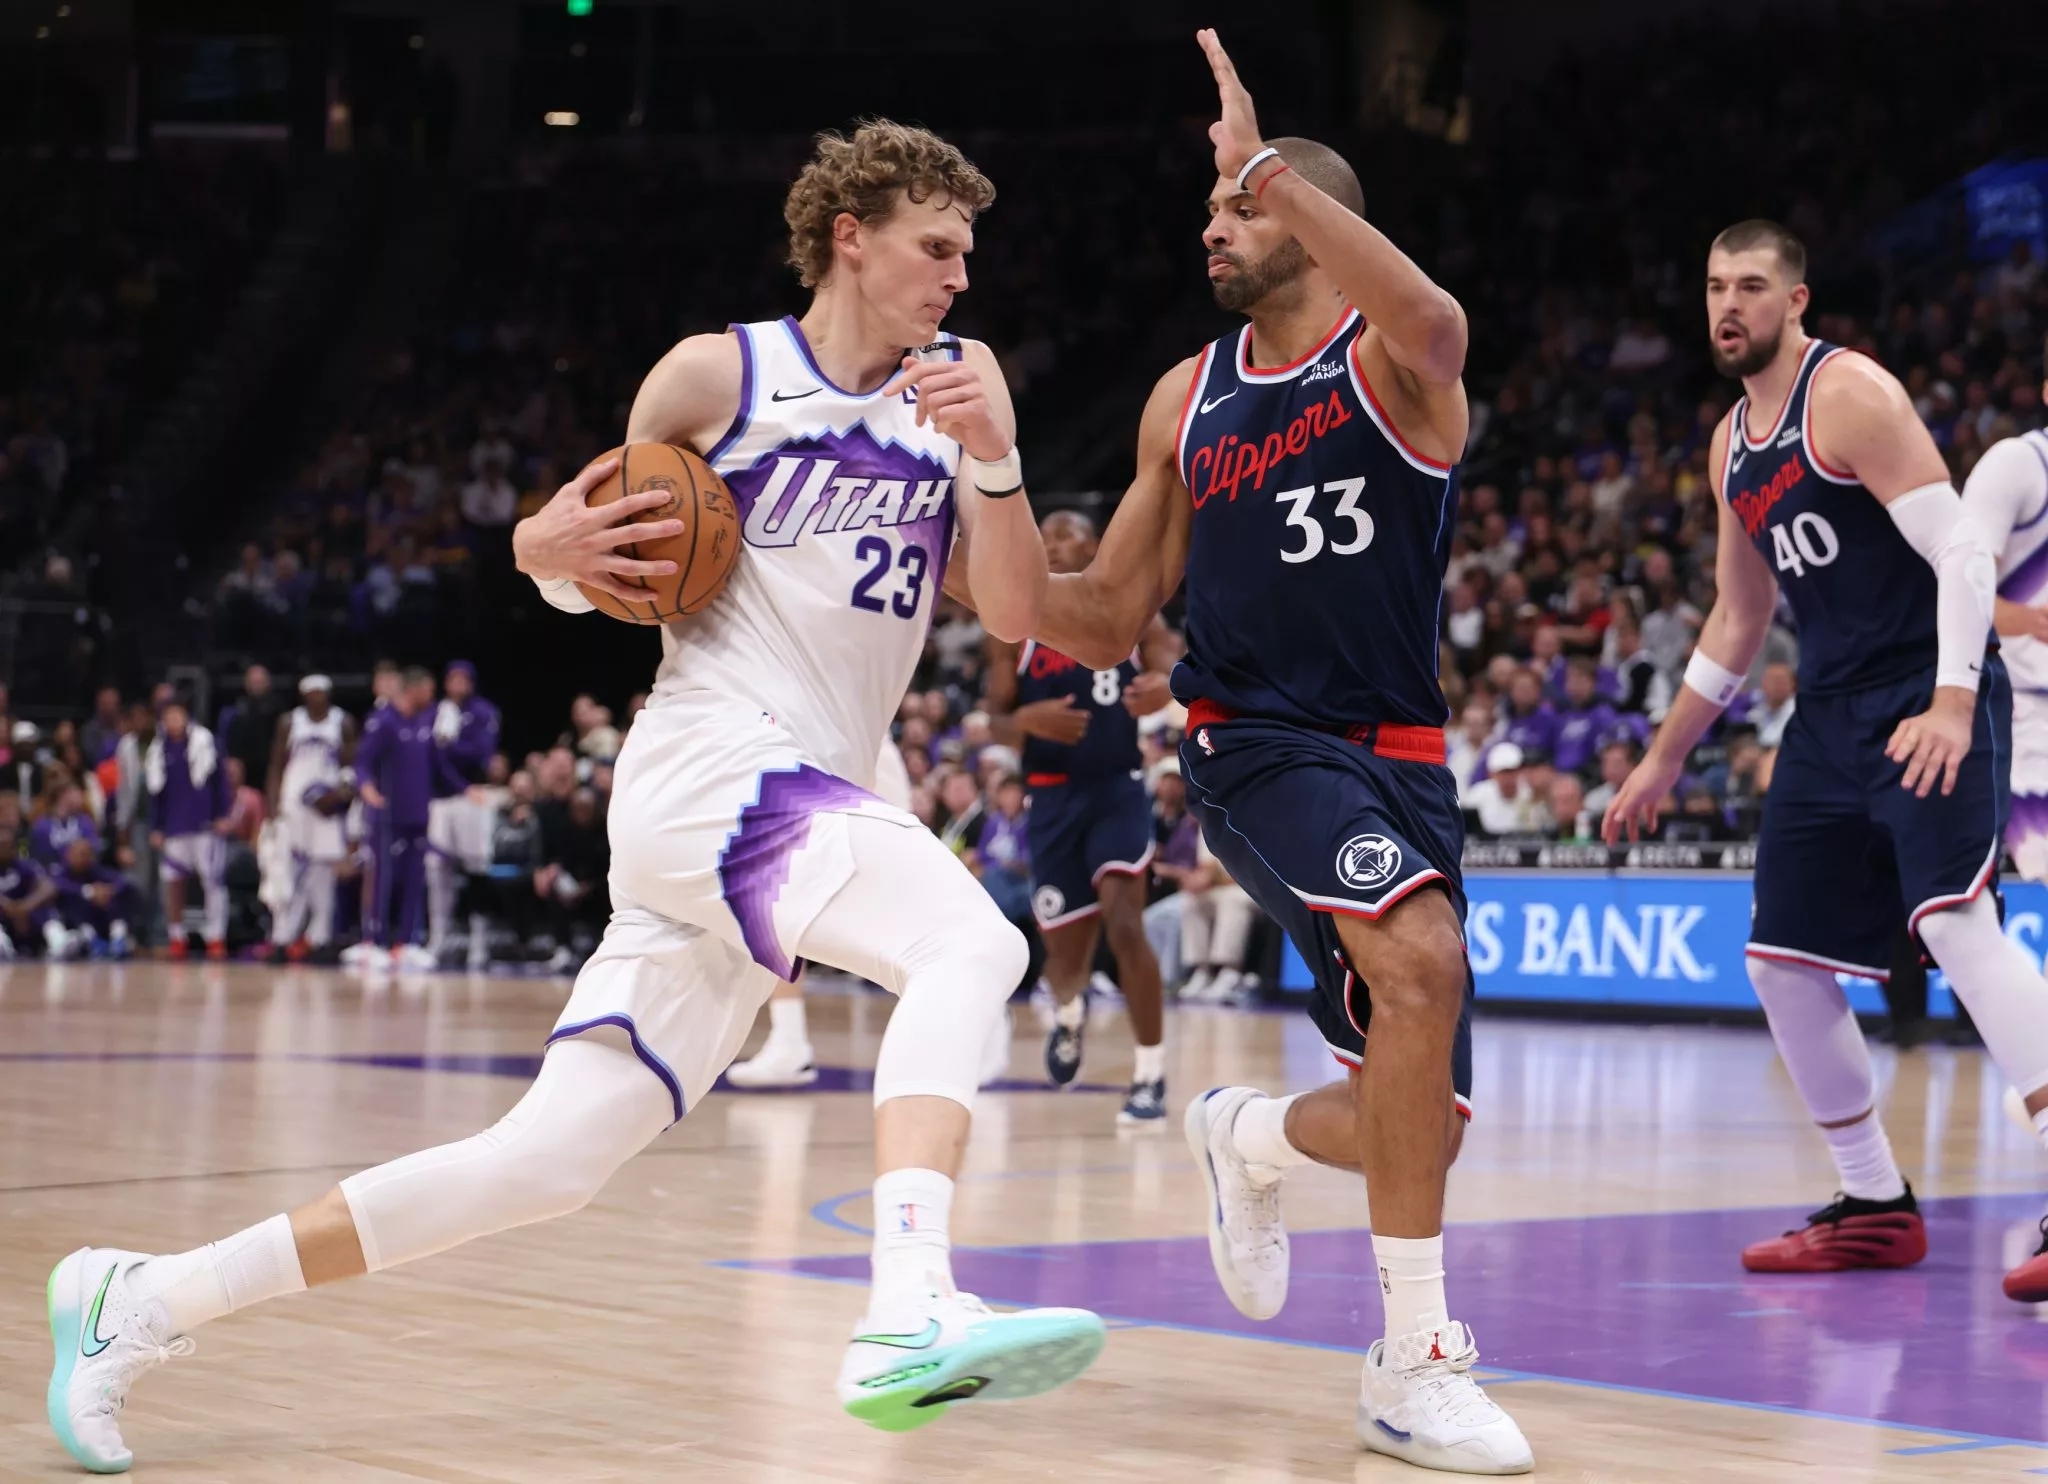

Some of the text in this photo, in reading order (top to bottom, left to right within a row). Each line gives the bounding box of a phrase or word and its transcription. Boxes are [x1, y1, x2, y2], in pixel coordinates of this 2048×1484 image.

[1301, 364, 1345, 387] RWANDA
[1311, 360, 1337, 373] VISIT
[1191, 390, 1351, 510] Clippers
[742, 455, 956, 548] UTAH
[1274, 476, 1375, 564] 33
[850, 535, 928, 620] 23
[1769, 511, 1839, 578] 40
[1091, 667, 1120, 706] 8
[1516, 901, 1717, 983] BANK
